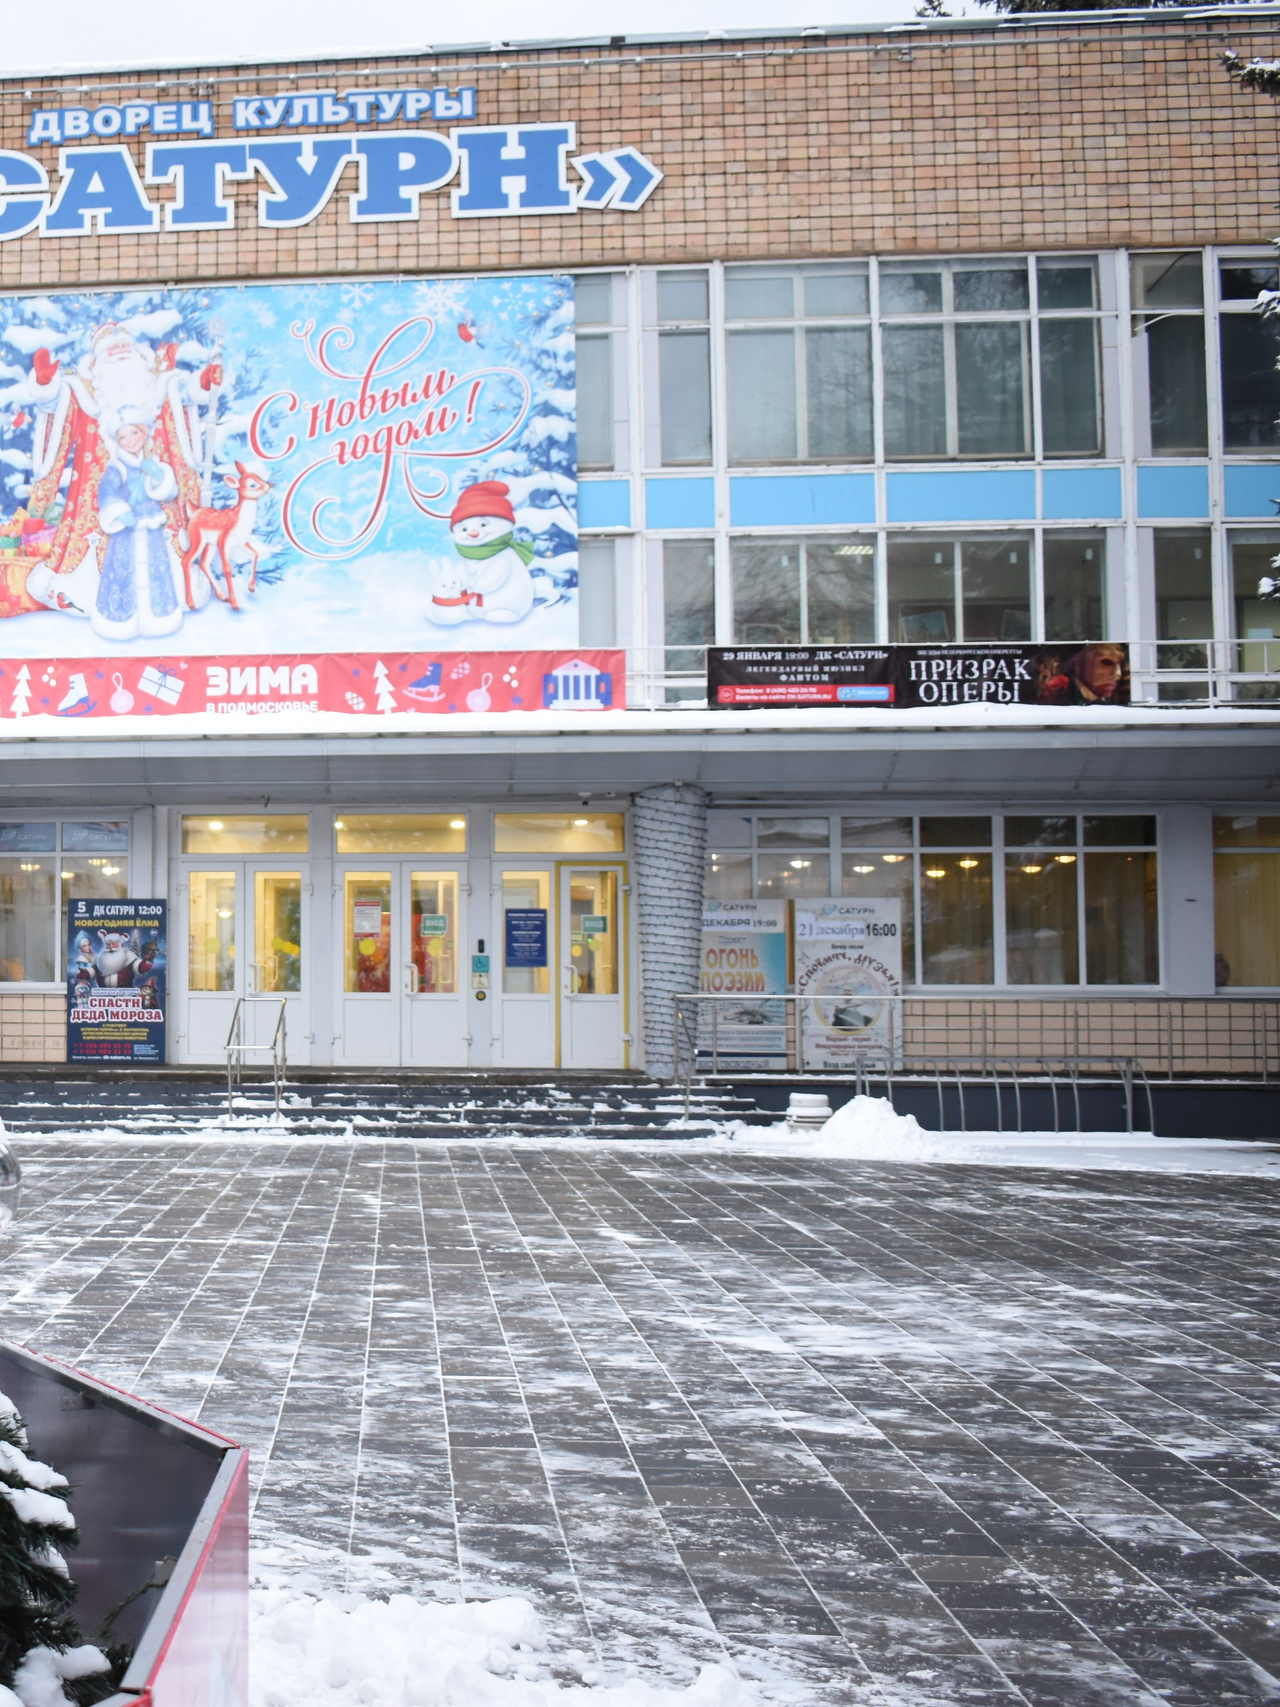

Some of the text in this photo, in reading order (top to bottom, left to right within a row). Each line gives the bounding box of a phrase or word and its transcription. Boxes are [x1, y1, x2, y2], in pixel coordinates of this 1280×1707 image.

[30, 88, 476, 143] ДВОРЕЦ КУЛЬТУРЫ
[250, 343, 458, 461] С Новым
[722, 650, 888, 660] 29 ЯНВАРЯ 19:00 ДК «САТУРН»
[746, 665, 819, 673] ЛЕГЕНДАРНЫЙ
[909, 659, 1031, 680] ПРИЗРАК
[206, 664, 318, 696] ЗИМА
[779, 673, 829, 681] ФАНТОМ
[919, 681, 1020, 702] ОПЕРЫ
[206, 701, 318, 713] В ПОДМОСКОВЬЕ
[77, 901, 87, 913] 5
[93, 905, 162, 917] ДК САТУРН 12:00
[74, 917, 159, 928] НОВОГОДНЯЯ ЁЛКА
[702, 919, 777, 927] ДЕКАБРЯ 19:00
[799, 923, 813, 936] 21
[866, 923, 897, 936] 16:00
[706, 948, 759, 969] ОГОНЬ
[701, 971, 765, 992] ПОЭЗИИ
[71, 1010, 163, 1021] ДЕДА МОРОЗА
